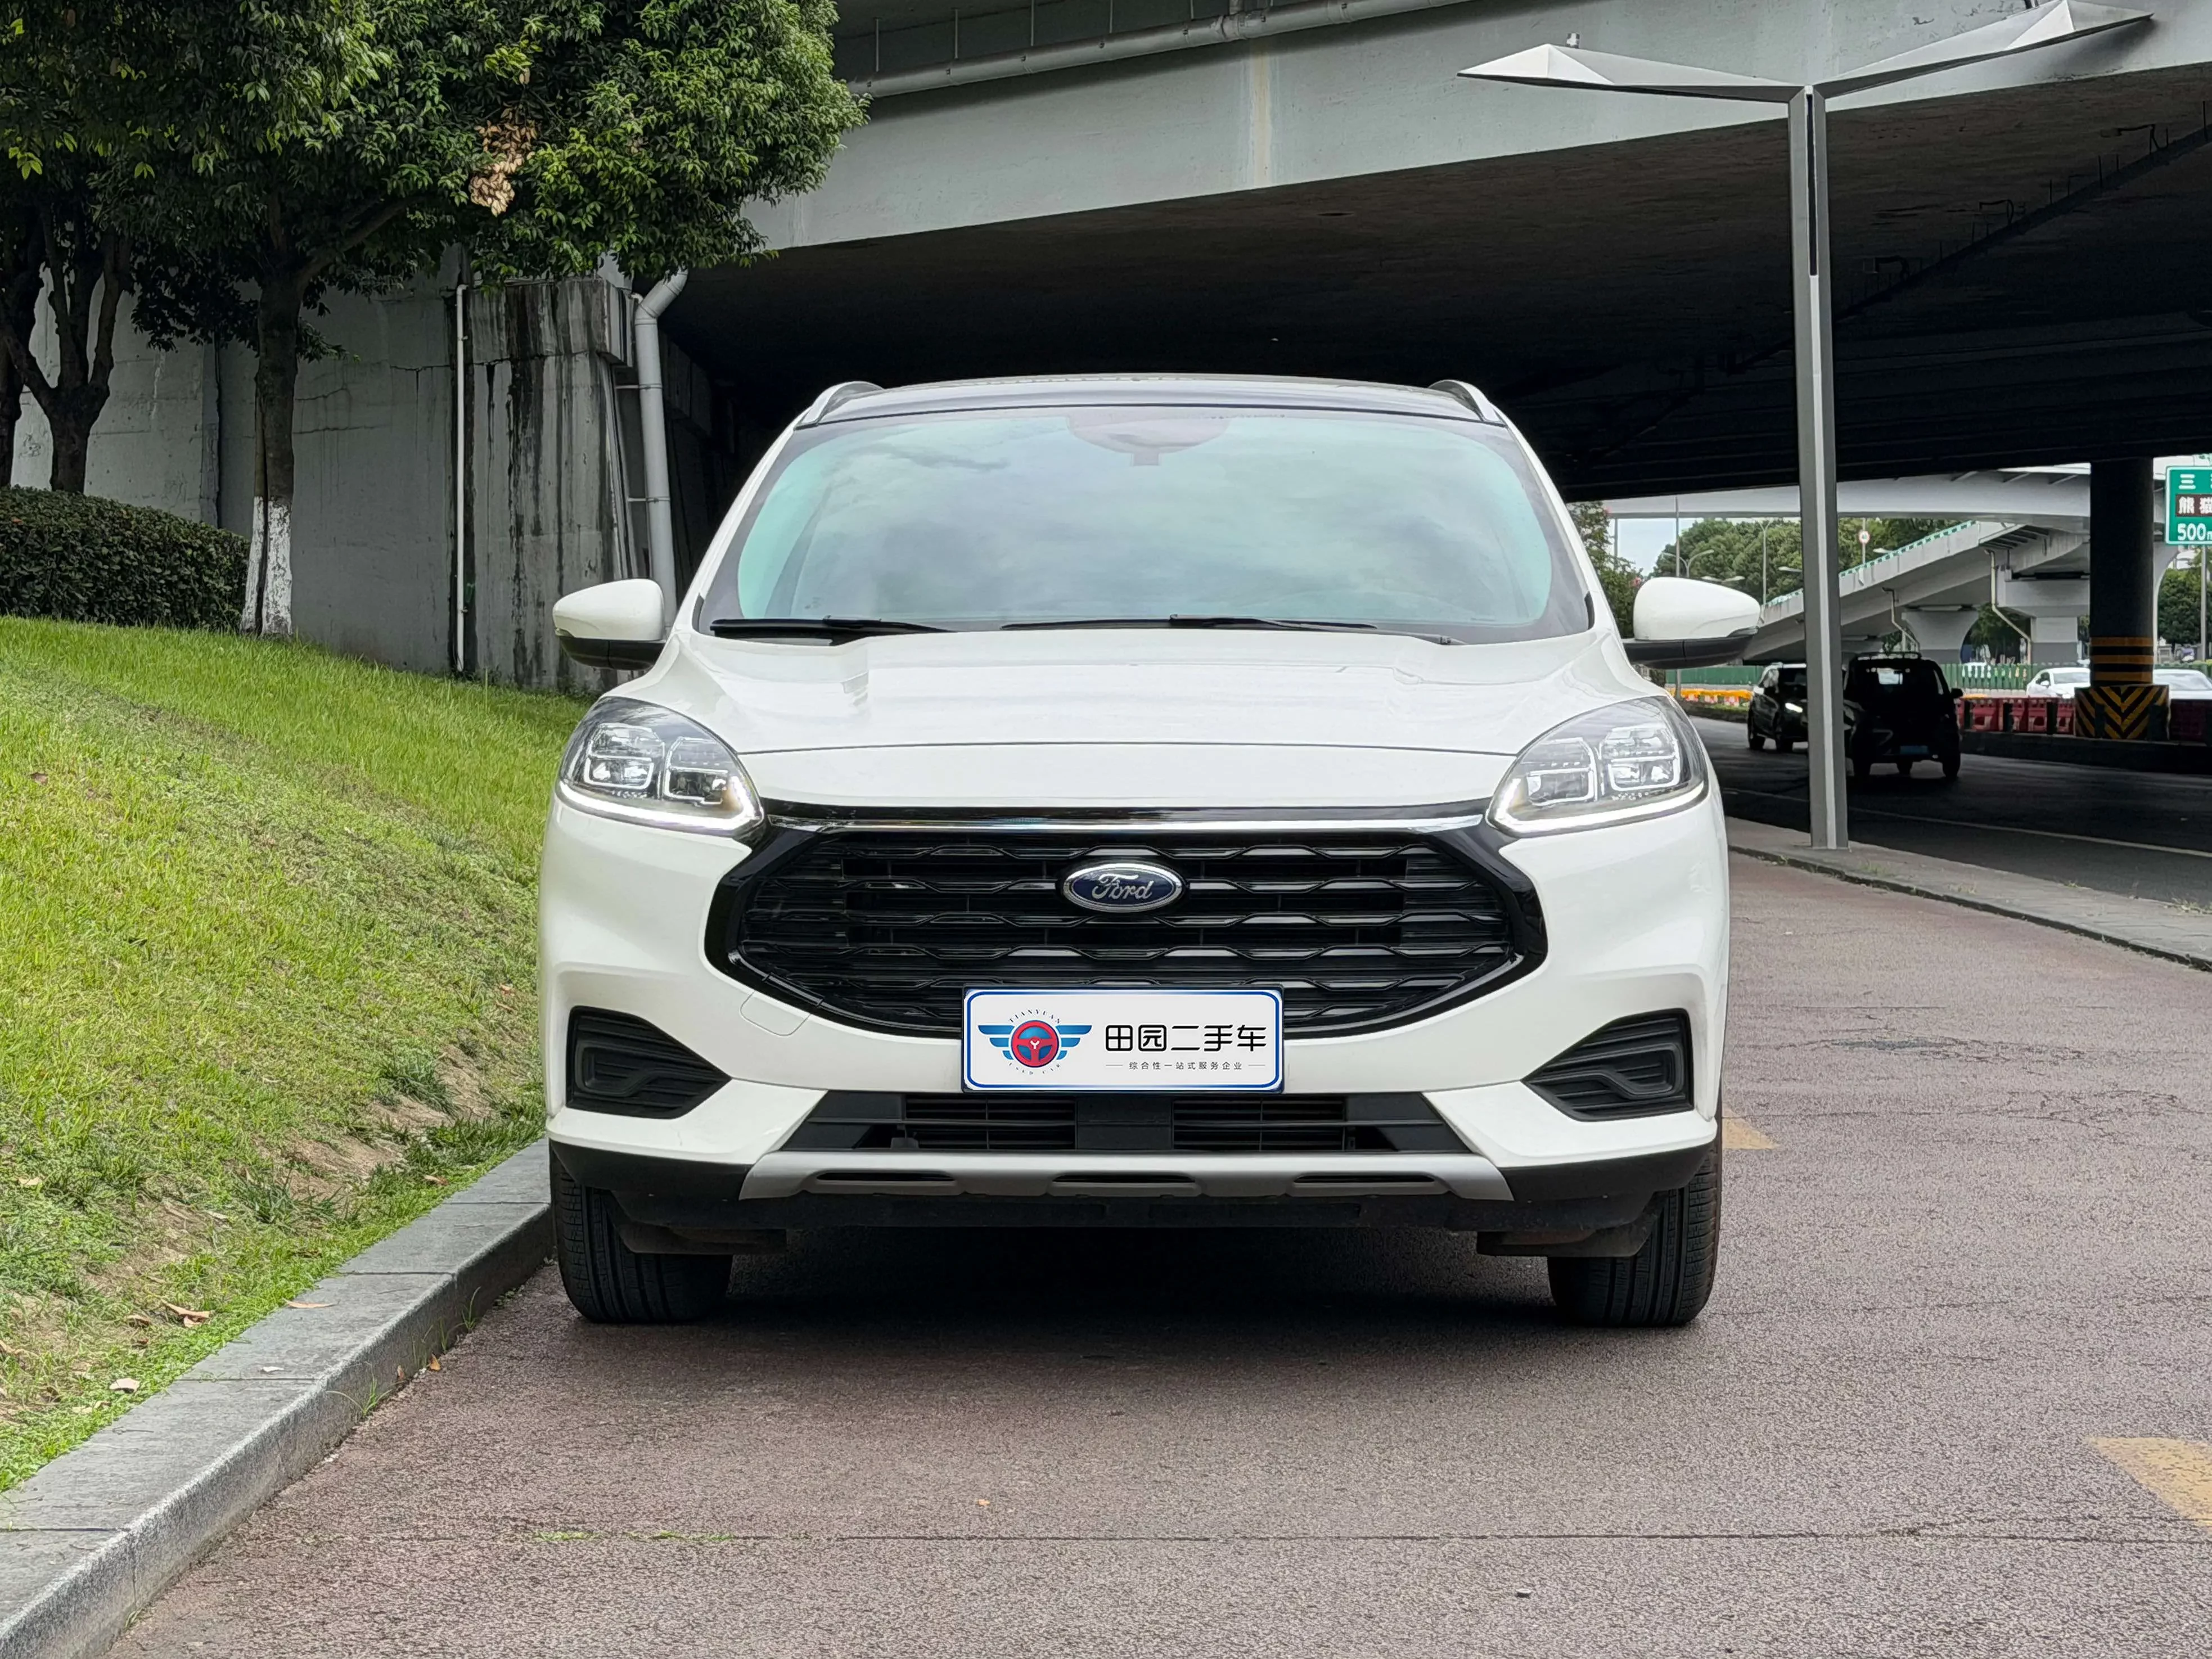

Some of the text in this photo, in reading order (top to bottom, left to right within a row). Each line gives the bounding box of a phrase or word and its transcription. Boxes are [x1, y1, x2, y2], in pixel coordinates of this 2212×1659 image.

[2178, 474, 2212, 490] 三
[1092, 873, 1154, 899] Ford
[1106, 1025, 1266, 1051] 田园二手车
[1129, 1061, 1242, 1070] 综合性一站式服务企业
